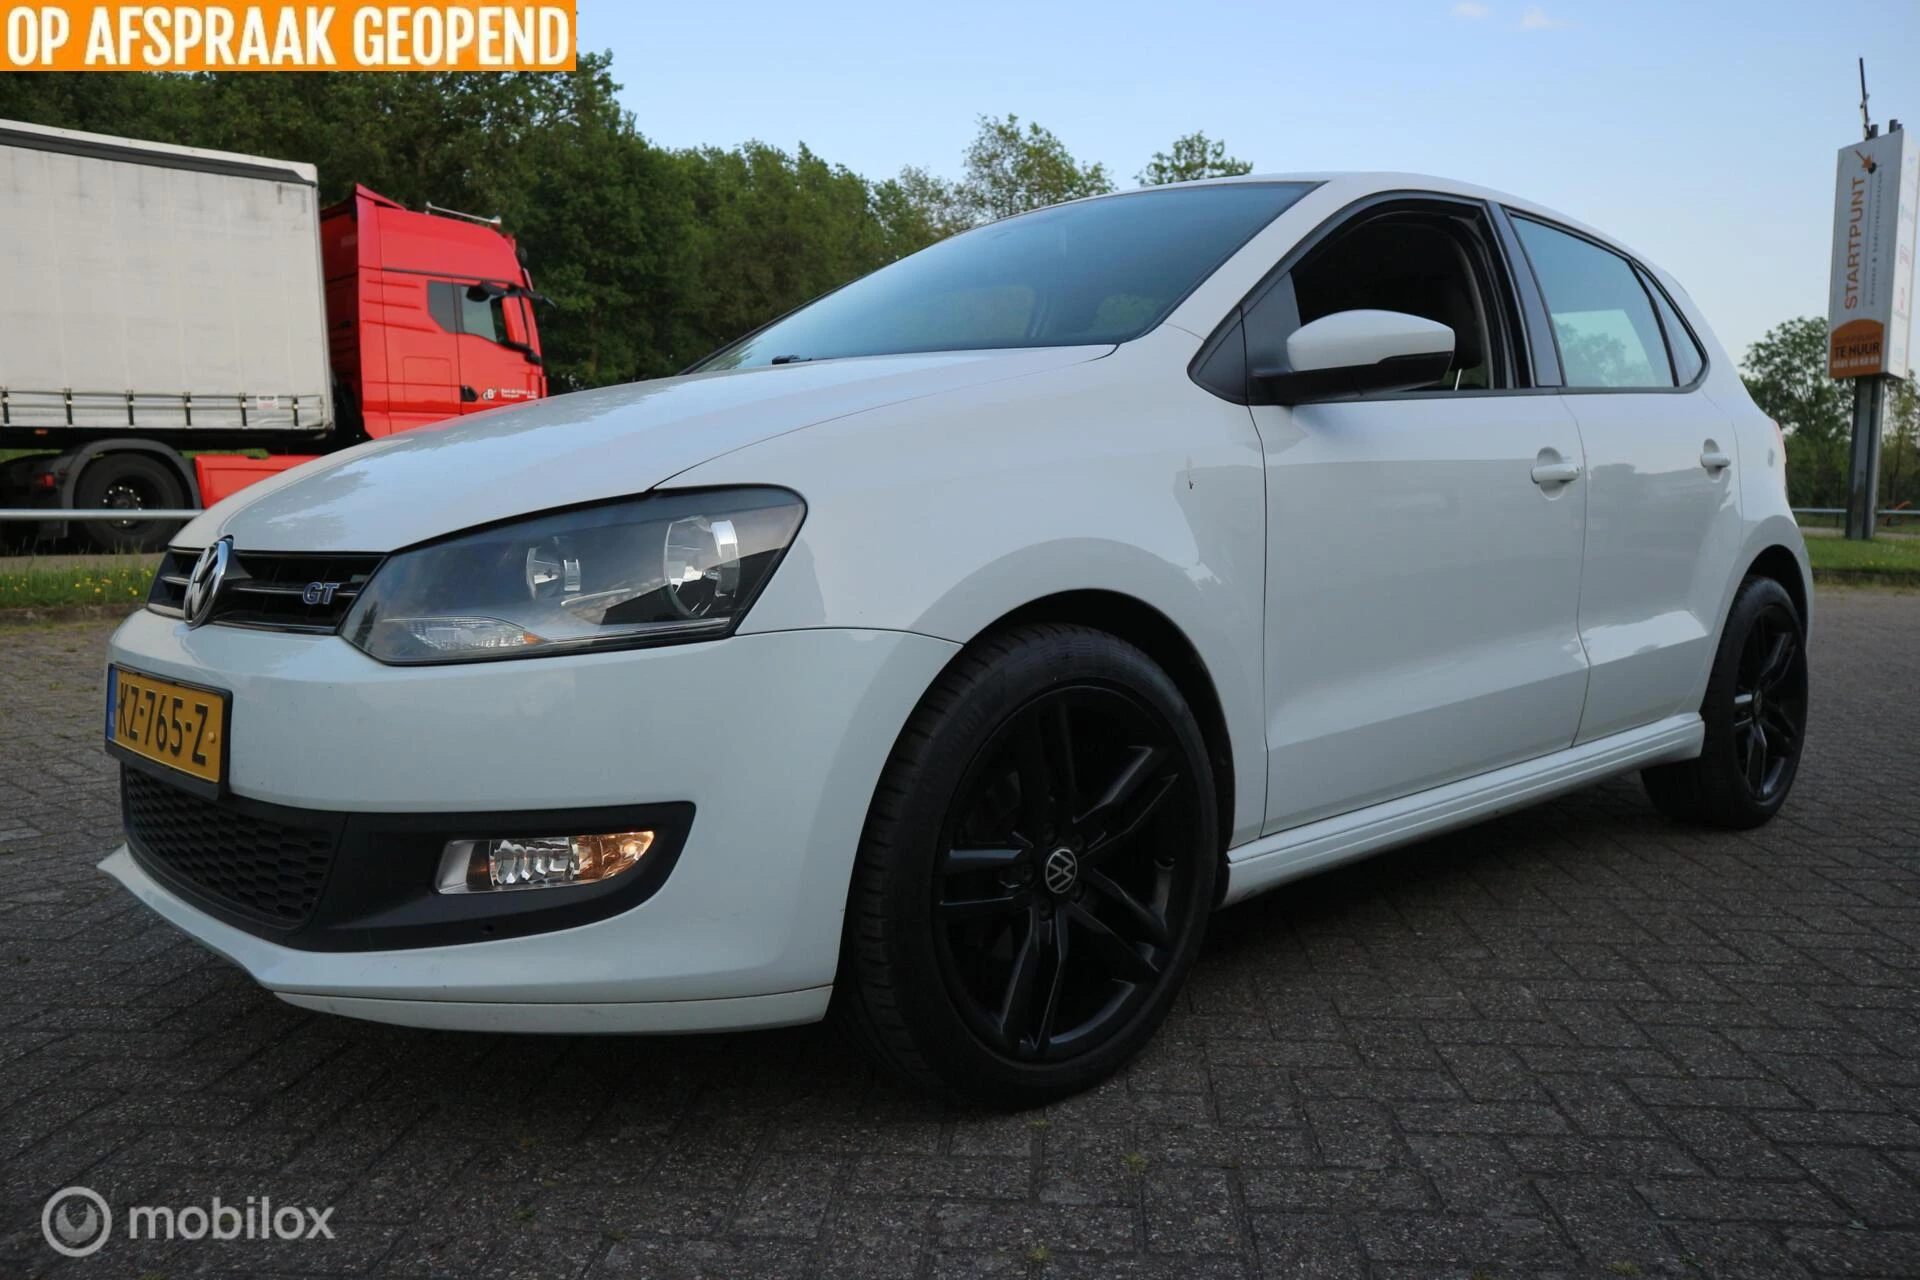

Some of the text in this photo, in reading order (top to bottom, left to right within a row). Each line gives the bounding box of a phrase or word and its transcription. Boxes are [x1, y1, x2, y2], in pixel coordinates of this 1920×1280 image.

[1844, 177, 1865, 310] STARTPUNT
[303, 582, 339, 605] GT
[118, 682, 209, 767] KZ-765-Z
